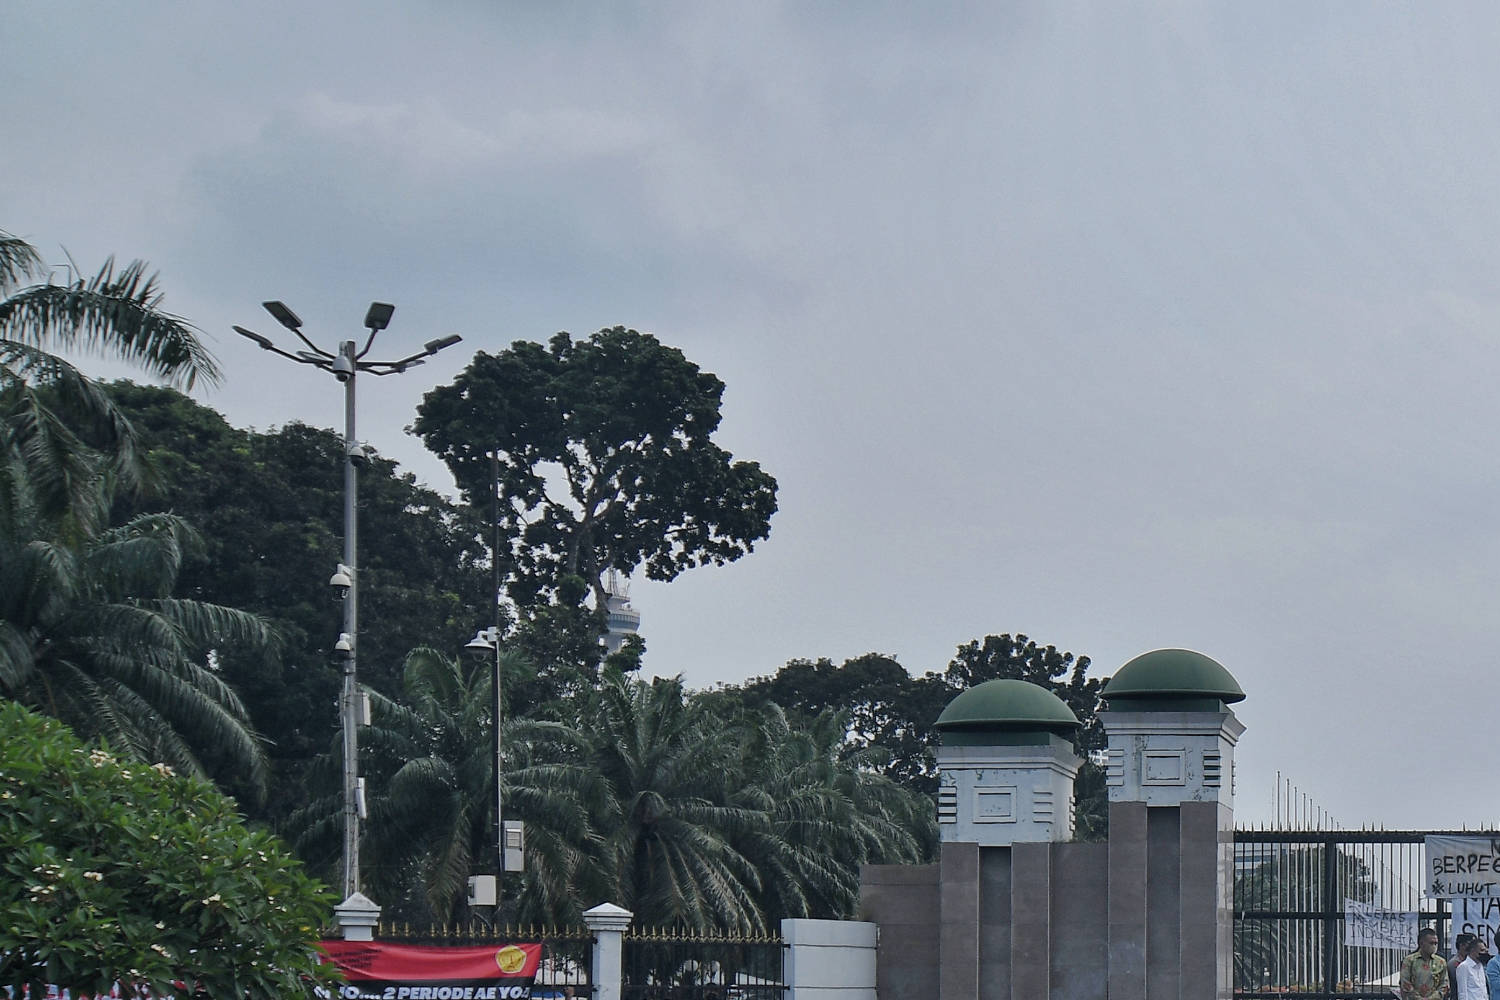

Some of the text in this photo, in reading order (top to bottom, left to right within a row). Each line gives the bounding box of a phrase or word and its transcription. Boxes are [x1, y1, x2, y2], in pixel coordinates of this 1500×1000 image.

[1449, 882, 1497, 895] LUHUT
[382, 987, 396, 1000] 2
[397, 987, 474, 1000] PERIODE
[474, 987, 496, 1000] AE
